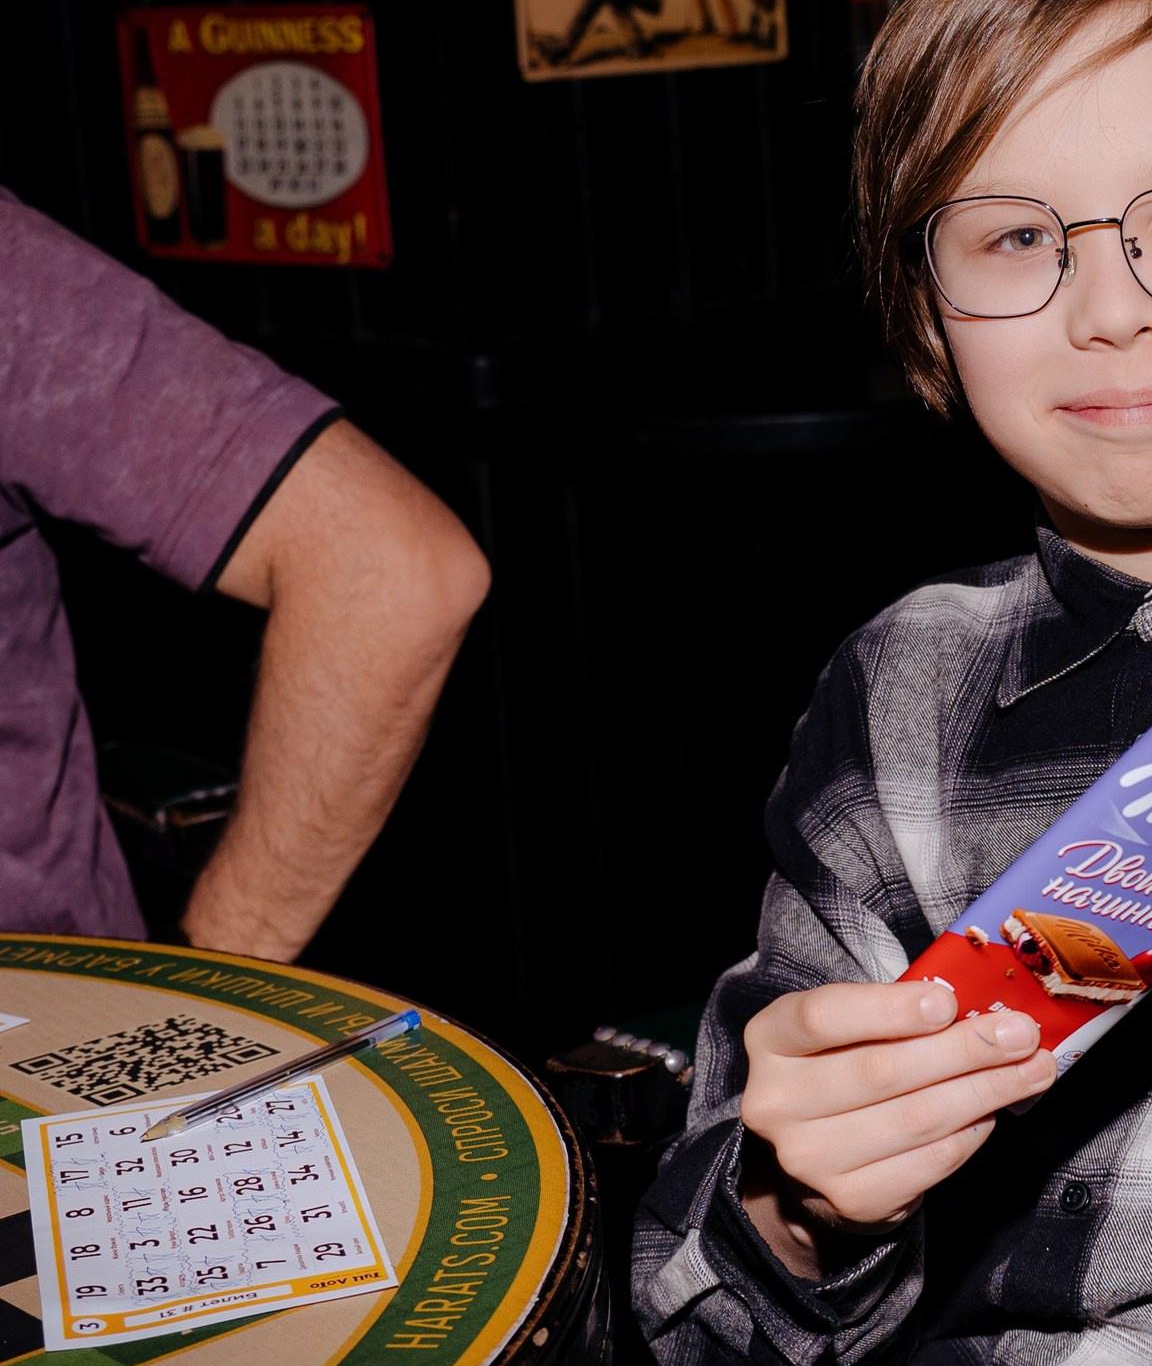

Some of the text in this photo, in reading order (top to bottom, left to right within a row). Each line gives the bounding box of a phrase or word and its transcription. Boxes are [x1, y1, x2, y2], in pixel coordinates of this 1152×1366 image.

[165, 11, 367, 57] A GUINNESS
[252, 210, 369, 267] a day!
[324, 1012, 464, 1088] ШАХМЫ
[264, 1099, 295, 1115] 27
[108, 1125, 137, 1136] 6
[427, 1085, 509, 1163] СПРОСИ
[54, 1132, 84, 1148] 15
[222, 1140, 253, 1156] 12
[275, 1130, 306, 1148] 14
[114, 1156, 145, 1176] 32
[168, 1148, 199, 1167] 30
[59, 1169, 89, 1184] 17
[287, 1163, 319, 1185] 34
[177, 1185, 208, 1204] 16
[232, 1175, 264, 1196] 28
[64, 1206, 95, 1218] 8
[121, 1196, 152, 1212] 11
[299, 1203, 332, 1223] 31
[186, 1223, 219, 1245] 22
[242, 1214, 276, 1235] 26
[69, 1243, 101, 1261] 18
[128, 1238, 160, 1250] 3
[312, 1241, 346, 1261] 29
[254, 1259, 286, 1270] 7
[384, 1195, 512, 1349] HARATS.COM
[195, 1264, 229, 1285] 25
[74, 1284, 107, 1299] 19
[135, 1275, 169, 1296] 33
[158, 1291, 259, 1318] Билет # 31
[78, 1321, 99, 1330] 3
